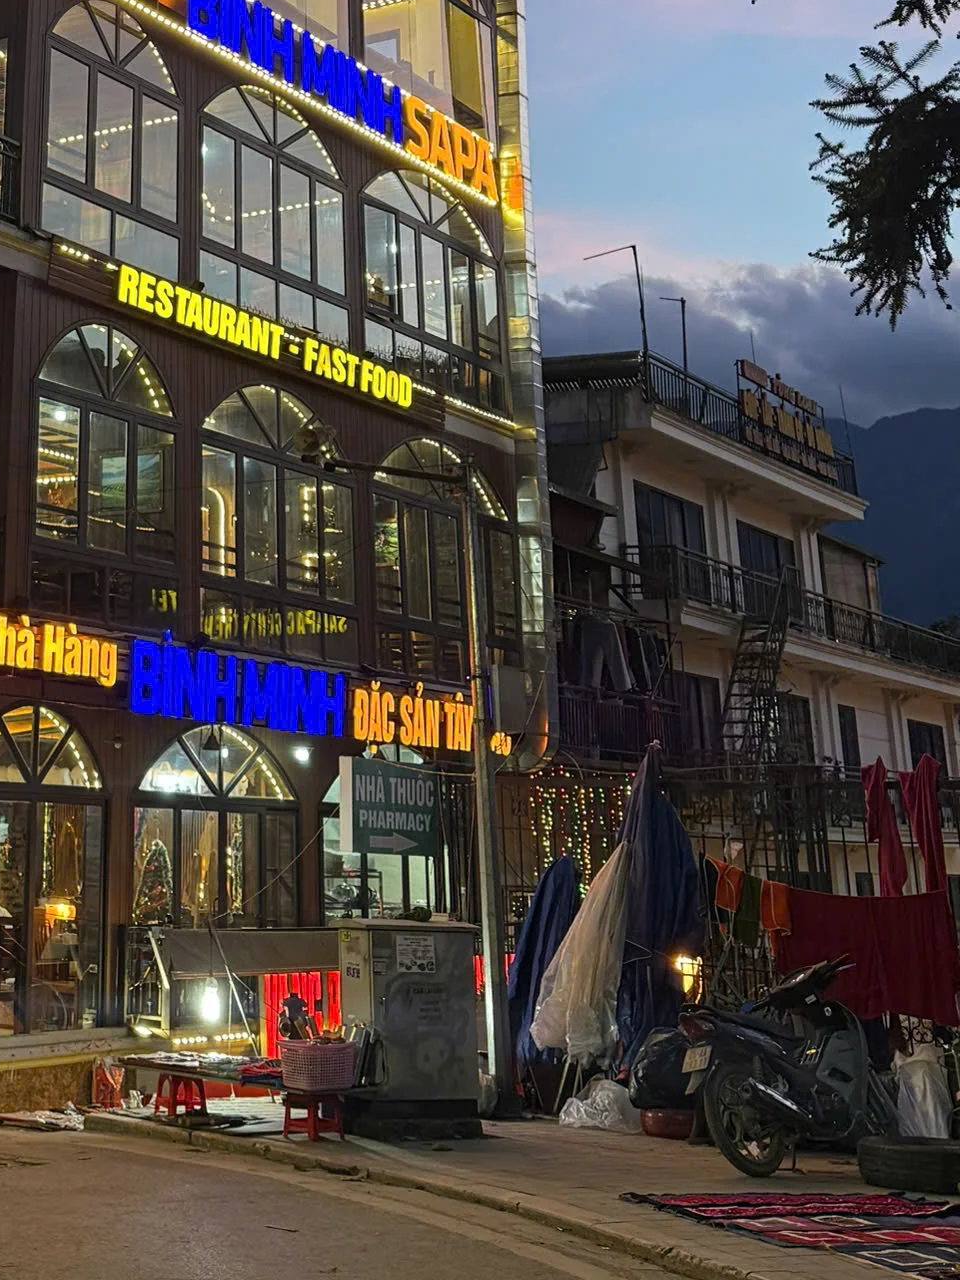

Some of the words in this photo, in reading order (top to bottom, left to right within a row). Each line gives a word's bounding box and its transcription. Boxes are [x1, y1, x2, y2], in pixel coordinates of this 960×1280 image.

[300, 31, 402, 147] MINH
[404, 96, 500, 204] SAPA
[117, 264, 285, 360] RESTAURANT
[303, 336, 362, 388] FAST
[359, 360, 413, 408] FOOD
[42, 623, 118, 688] Hàng
[129, 629, 237, 724] BÌNH
[240, 656, 345, 737] MINH
[353, 680, 395, 754] ĐẶC
[399, 682, 440, 748] SẢN
[355, 770, 385, 803] NHÀ
[359, 809, 432, 832] PHARMACY
